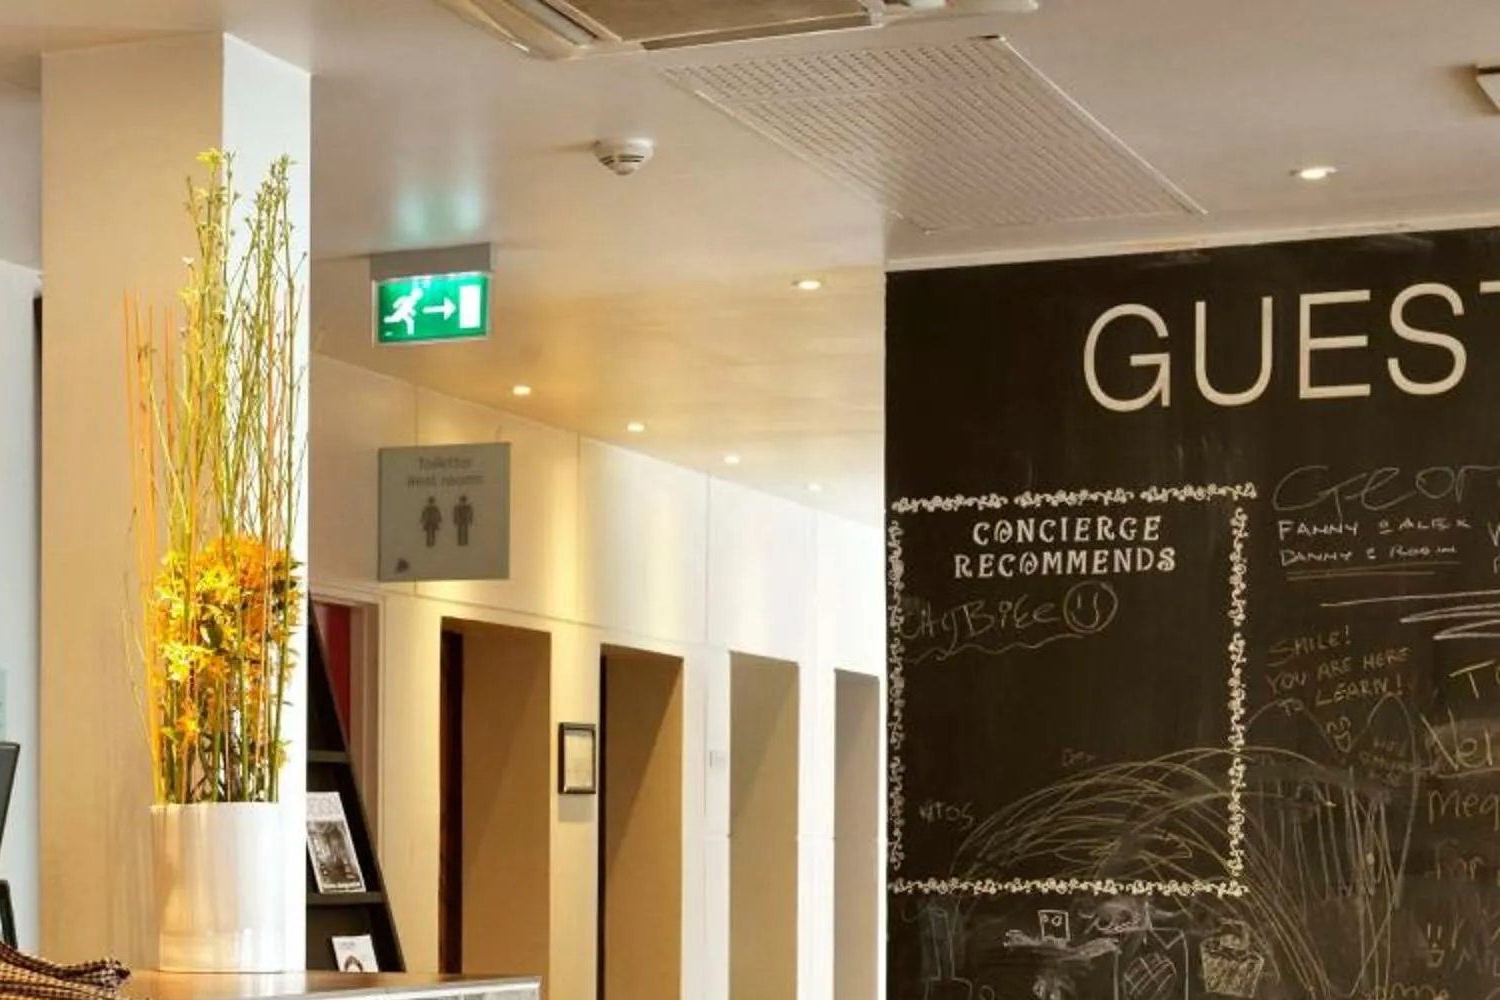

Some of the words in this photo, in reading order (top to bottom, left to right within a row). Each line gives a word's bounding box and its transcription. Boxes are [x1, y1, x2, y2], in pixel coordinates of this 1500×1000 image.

[1083, 281, 1500, 412] GUES
[972, 514, 1162, 546] CONCIERGE
[954, 546, 1176, 580] RECOMMENDS
[1265, 624, 1353, 668] SMILE!
[1265, 671, 1306, 697] YOU
[1317, 656, 1352, 681] ARE
[1362, 645, 1412, 670] HERE
